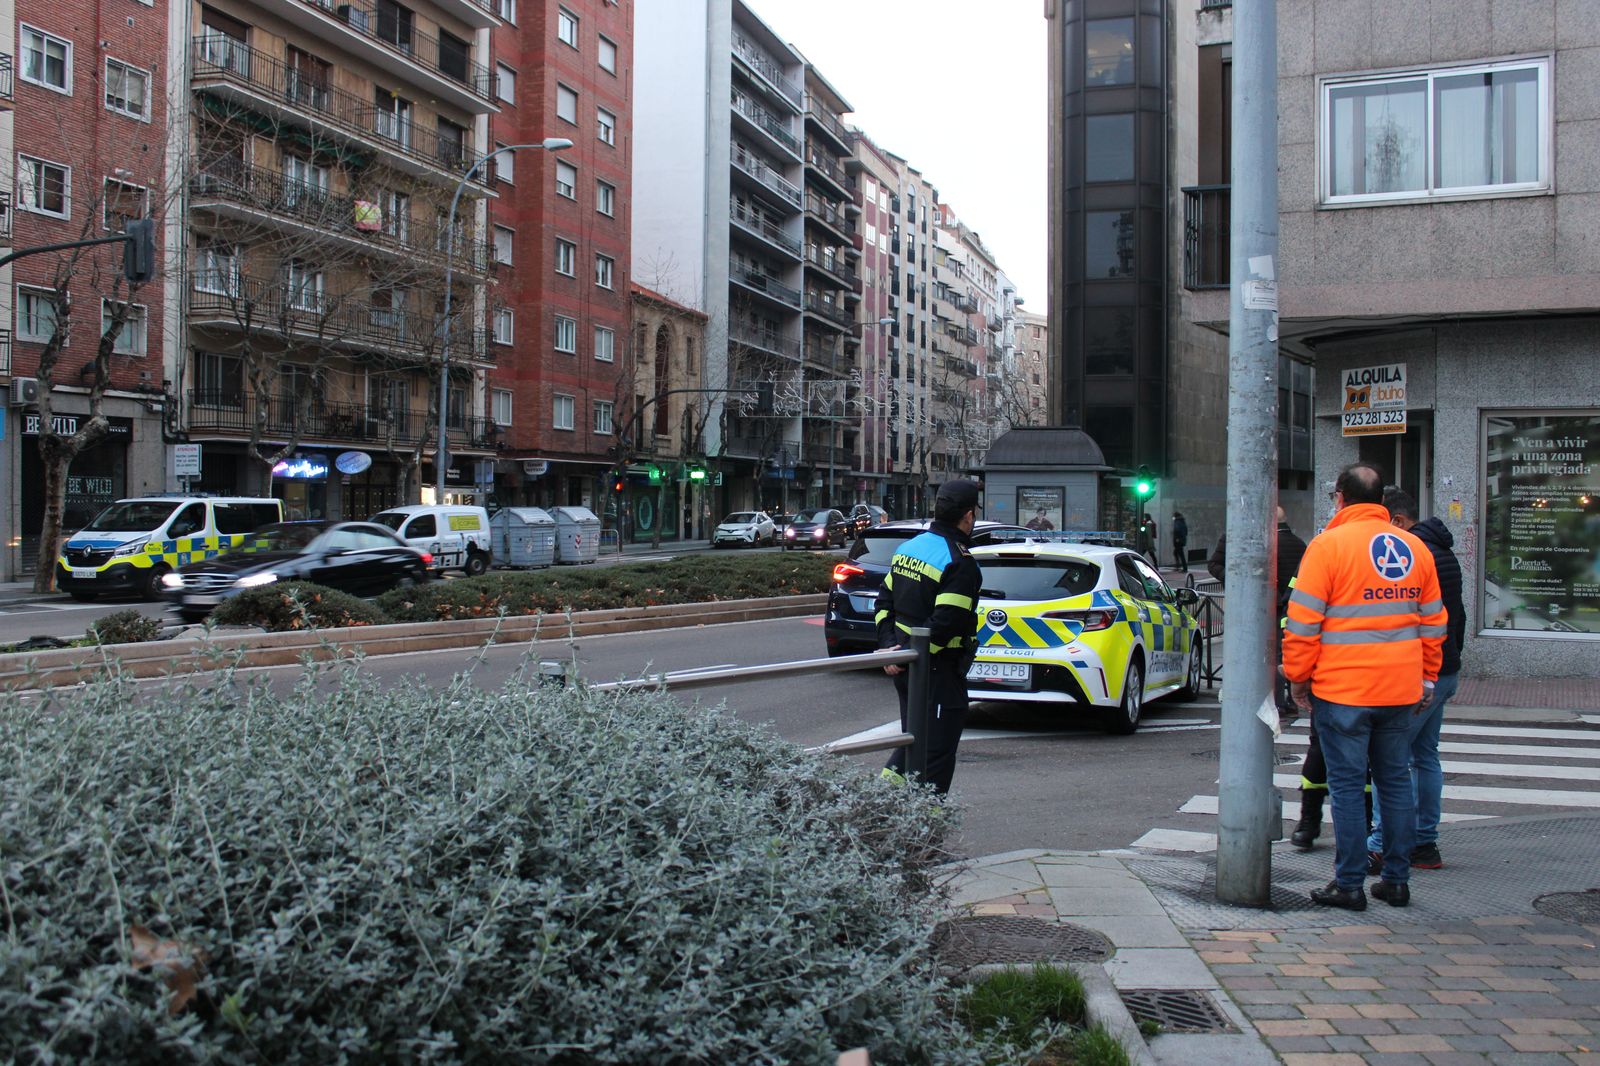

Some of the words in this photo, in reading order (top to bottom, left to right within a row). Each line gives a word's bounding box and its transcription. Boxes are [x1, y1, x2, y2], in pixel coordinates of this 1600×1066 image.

[1346, 366, 1402, 386] ALQUILA
[26, 416, 40, 433] BE
[1345, 413, 1363, 426] 923
[1365, 412, 1381, 424] 281
[1383, 410, 1404, 423] 323
[1546, 440, 1554, 448] a
[1557, 436, 1588, 448] vivir
[1512, 453, 1519, 461] a
[1523, 453, 1547, 461] una
[1551, 452, 1582, 461] zona
[68, 478, 82, 494] BE
[85, 478, 112, 494] WILD
[893, 566, 922, 582] SALAMANCA
[1002, 665, 1025, 677] LPB
